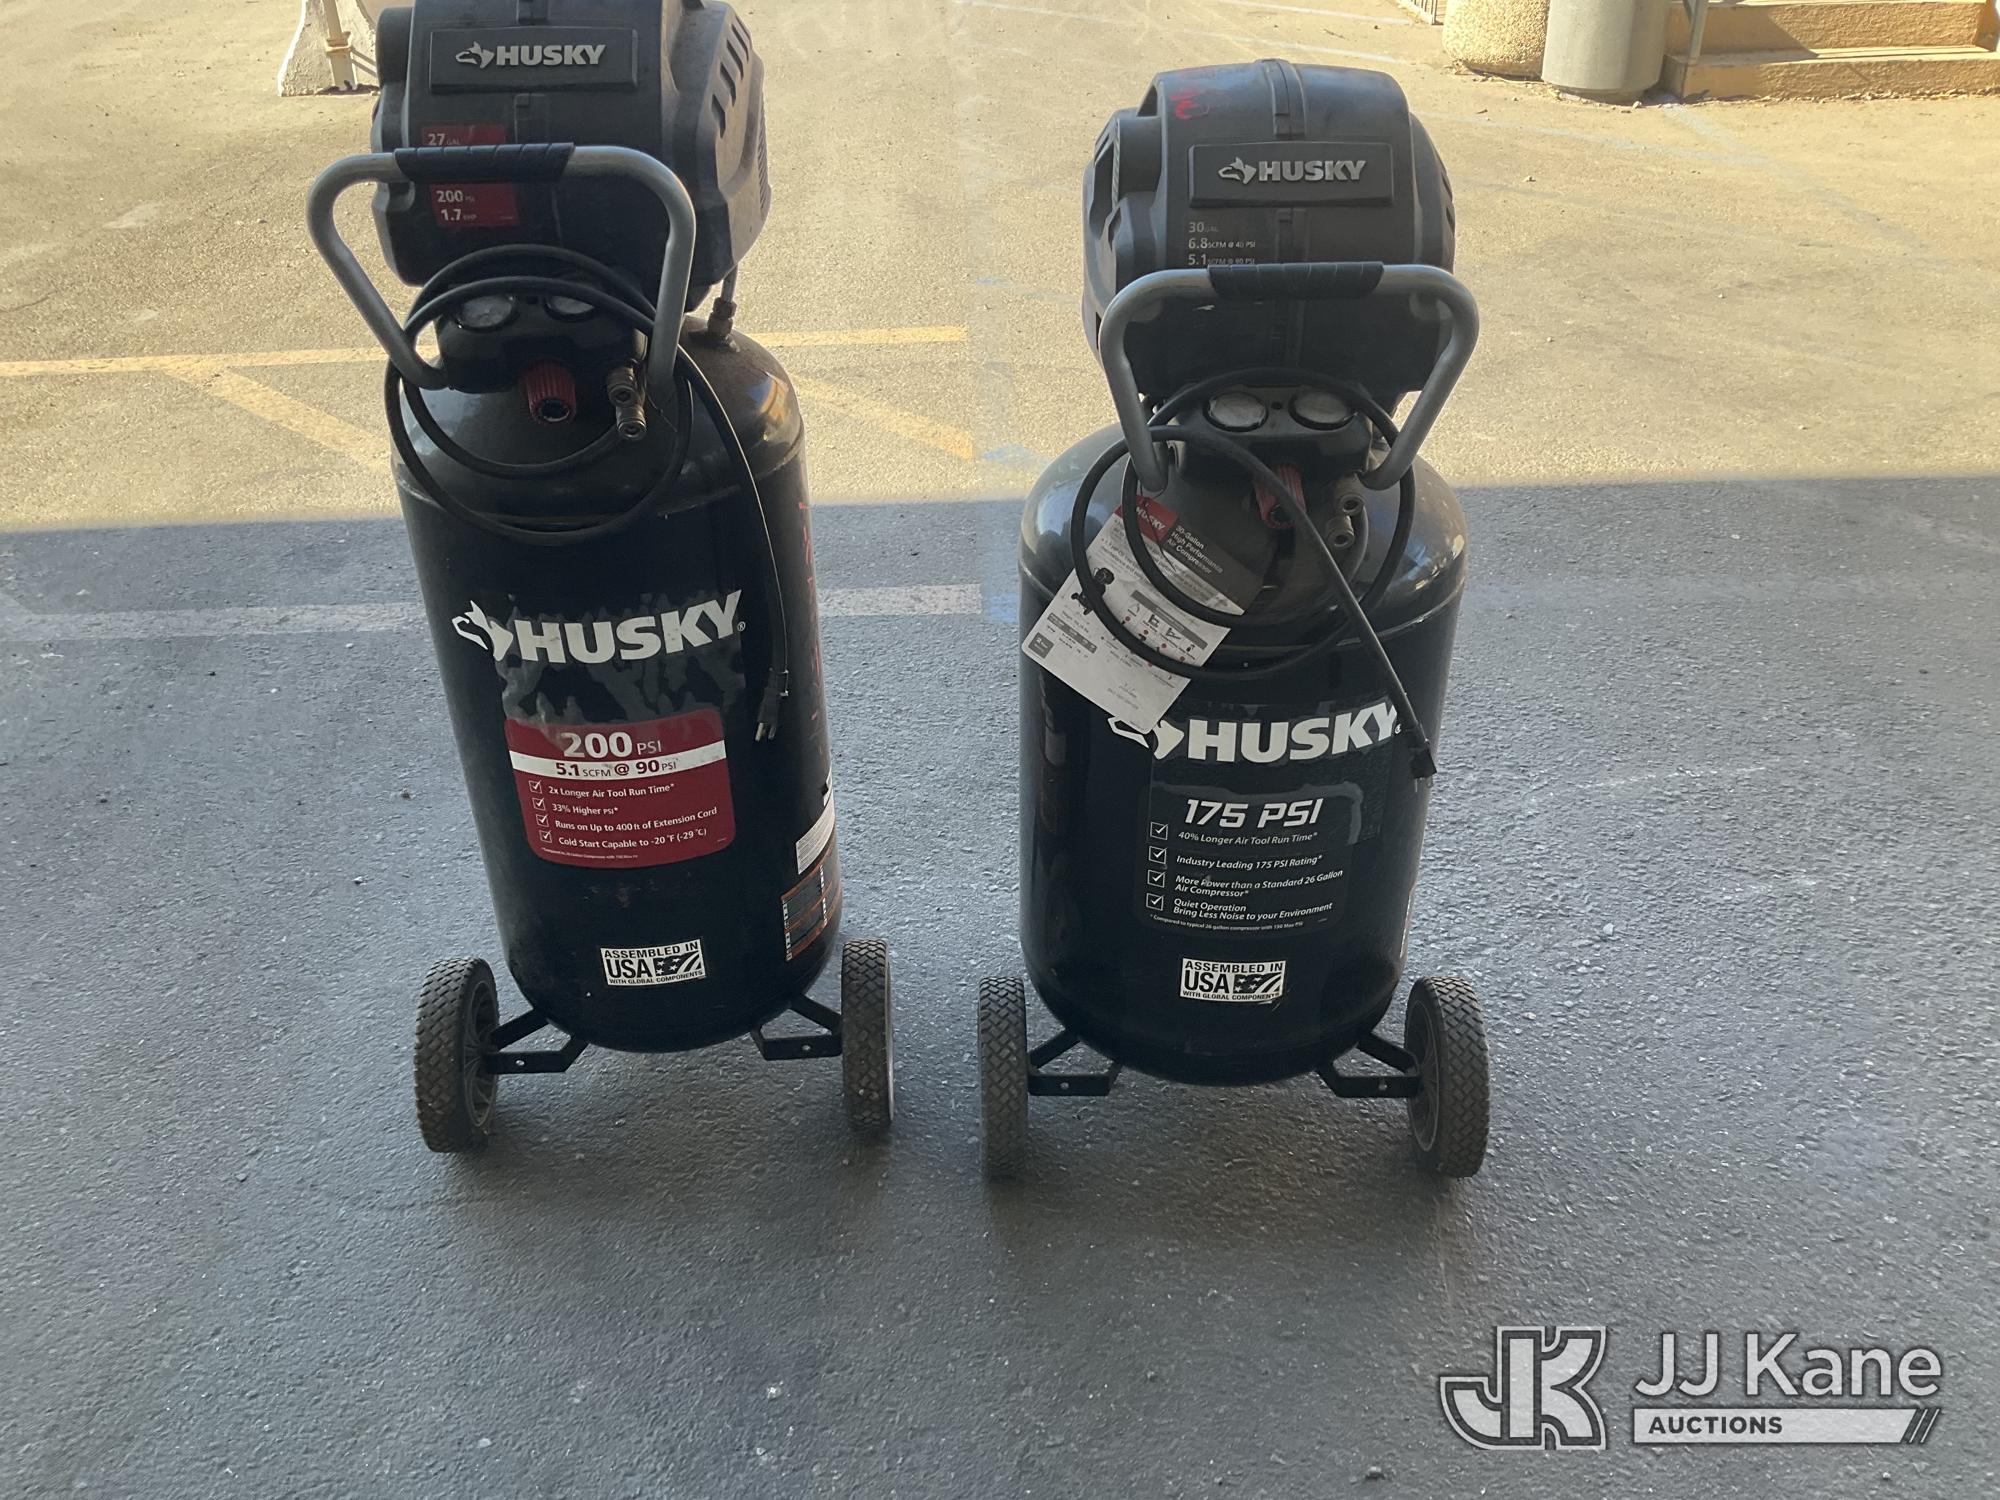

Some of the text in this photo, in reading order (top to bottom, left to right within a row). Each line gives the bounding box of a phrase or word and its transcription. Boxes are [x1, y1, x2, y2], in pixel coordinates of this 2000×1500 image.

[496, 44, 606, 66] HUSKY
[428, 133, 446, 146] 27
[1258, 160, 1366, 182] HUSKY
[436, 190, 464, 203] 200
[441, 208, 462, 221] 1.7
[1188, 222, 1205, 233] 30
[1171, 532, 1186, 548] High
[1175, 525, 1205, 550] 30-Gallon
[514, 589, 742, 663] HUSKY
[1188, 702, 1398, 763] HUSKY
[559, 731, 662, 758] 200 PSI
[556, 760, 677, 777] 5.1 SCFM @ 90 PSI
[549, 786, 559, 795] 2x
[560, 788, 590, 799] Longer
[592, 789, 604, 798] Air
[607, 788, 627, 797] Tool
[629, 787, 646, 796] Run
[552, 803, 571, 813] 33%
[573, 806, 601, 817] Higher
[1185, 798, 1324, 829] 175 PSI
[555, 820, 574, 831] Runs
[590, 824, 602, 833] Up
[604, 824, 614, 832] to
[616, 823, 632, 831] 400
[633, 823, 640, 831] ft
[642, 820, 652, 829] of
[653, 813, 695, 829] Extension
[697, 806, 718, 819] Cord
[558, 837, 577, 847] Cold
[579, 838, 600, 848] Start
[602, 838, 637, 850] Capable
[639, 838, 649, 847] to
[651, 836, 666, 845] -20
[676, 831, 694, 842] (-29
[1178, 831, 1199, 841] 40%
[1201, 834, 1233, 846] Longer
[1235, 837, 1249, 845] Air
[1251, 836, 1270, 845] Tool
[1272, 835, 1289, 844] Run
[1176, 855, 1215, 869] Industry
[1216, 860, 1253, 871] Leading
[1256, 860, 1272, 869] 175
[1273, 859, 1288, 868] PSI
[1175, 875, 1200, 886] More
[1201, 878, 1230, 889] Power
[1231, 880, 1253, 889] than
[1262, 878, 1303, 889] Standard
[1304, 875, 1315, 885] 26
[1316, 870, 1344, 883] Gallon
[1175, 884, 1188, 893] Air
[1173, 902, 1333, 922] Bring Less Noise to your Environment
[1174, 898, 1247, 912] Quiet Operation
[1153, 915, 1180, 925] Compared
[1187, 920, 1205, 928] typical
[604, 941, 698, 959] ASSEMBLED IN
[605, 958, 653, 979] USA
[1185, 961, 1283, 973] ASSEMBLED IN
[628, 977, 655, 985] GLOBAL
[656, 970, 703, 983] COMPONENTS
[1184, 969, 1230, 994] USA
[1183, 990, 1201, 998] WITH
